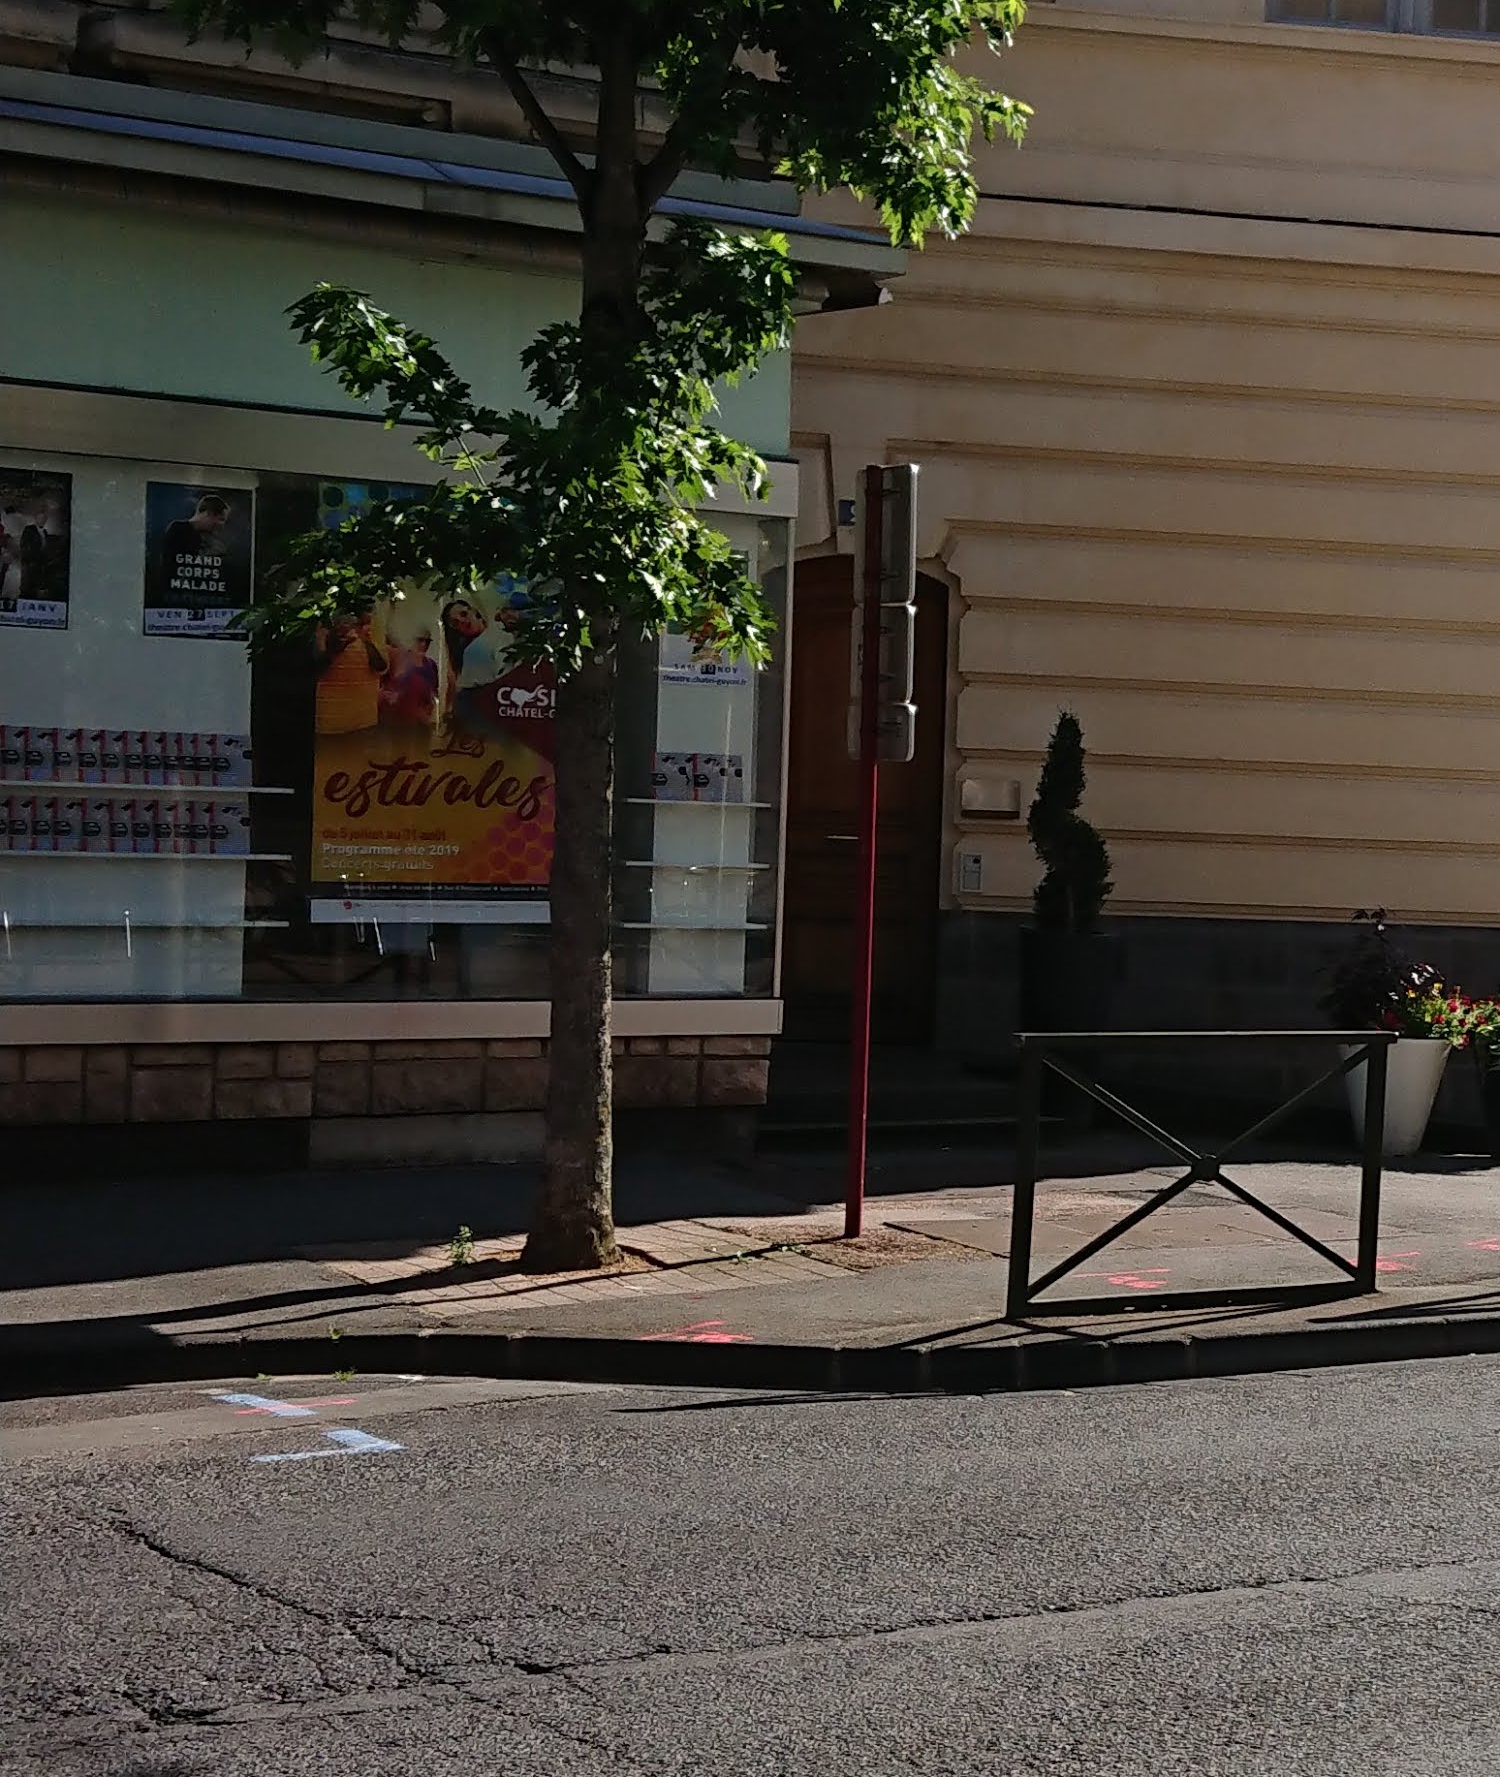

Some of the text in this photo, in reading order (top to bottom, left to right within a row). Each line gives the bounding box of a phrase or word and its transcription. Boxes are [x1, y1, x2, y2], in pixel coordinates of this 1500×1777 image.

[175, 553, 222, 567] GRAND
[177, 566, 220, 579] CORPS
[170, 579, 226, 592] MALADE
[157, 610, 182, 619] VEN
[717, 666, 738, 674] NOV
[323, 756, 551, 821] estivales
[322, 843, 401, 857] Programme
[429, 843, 460, 856] 2019
